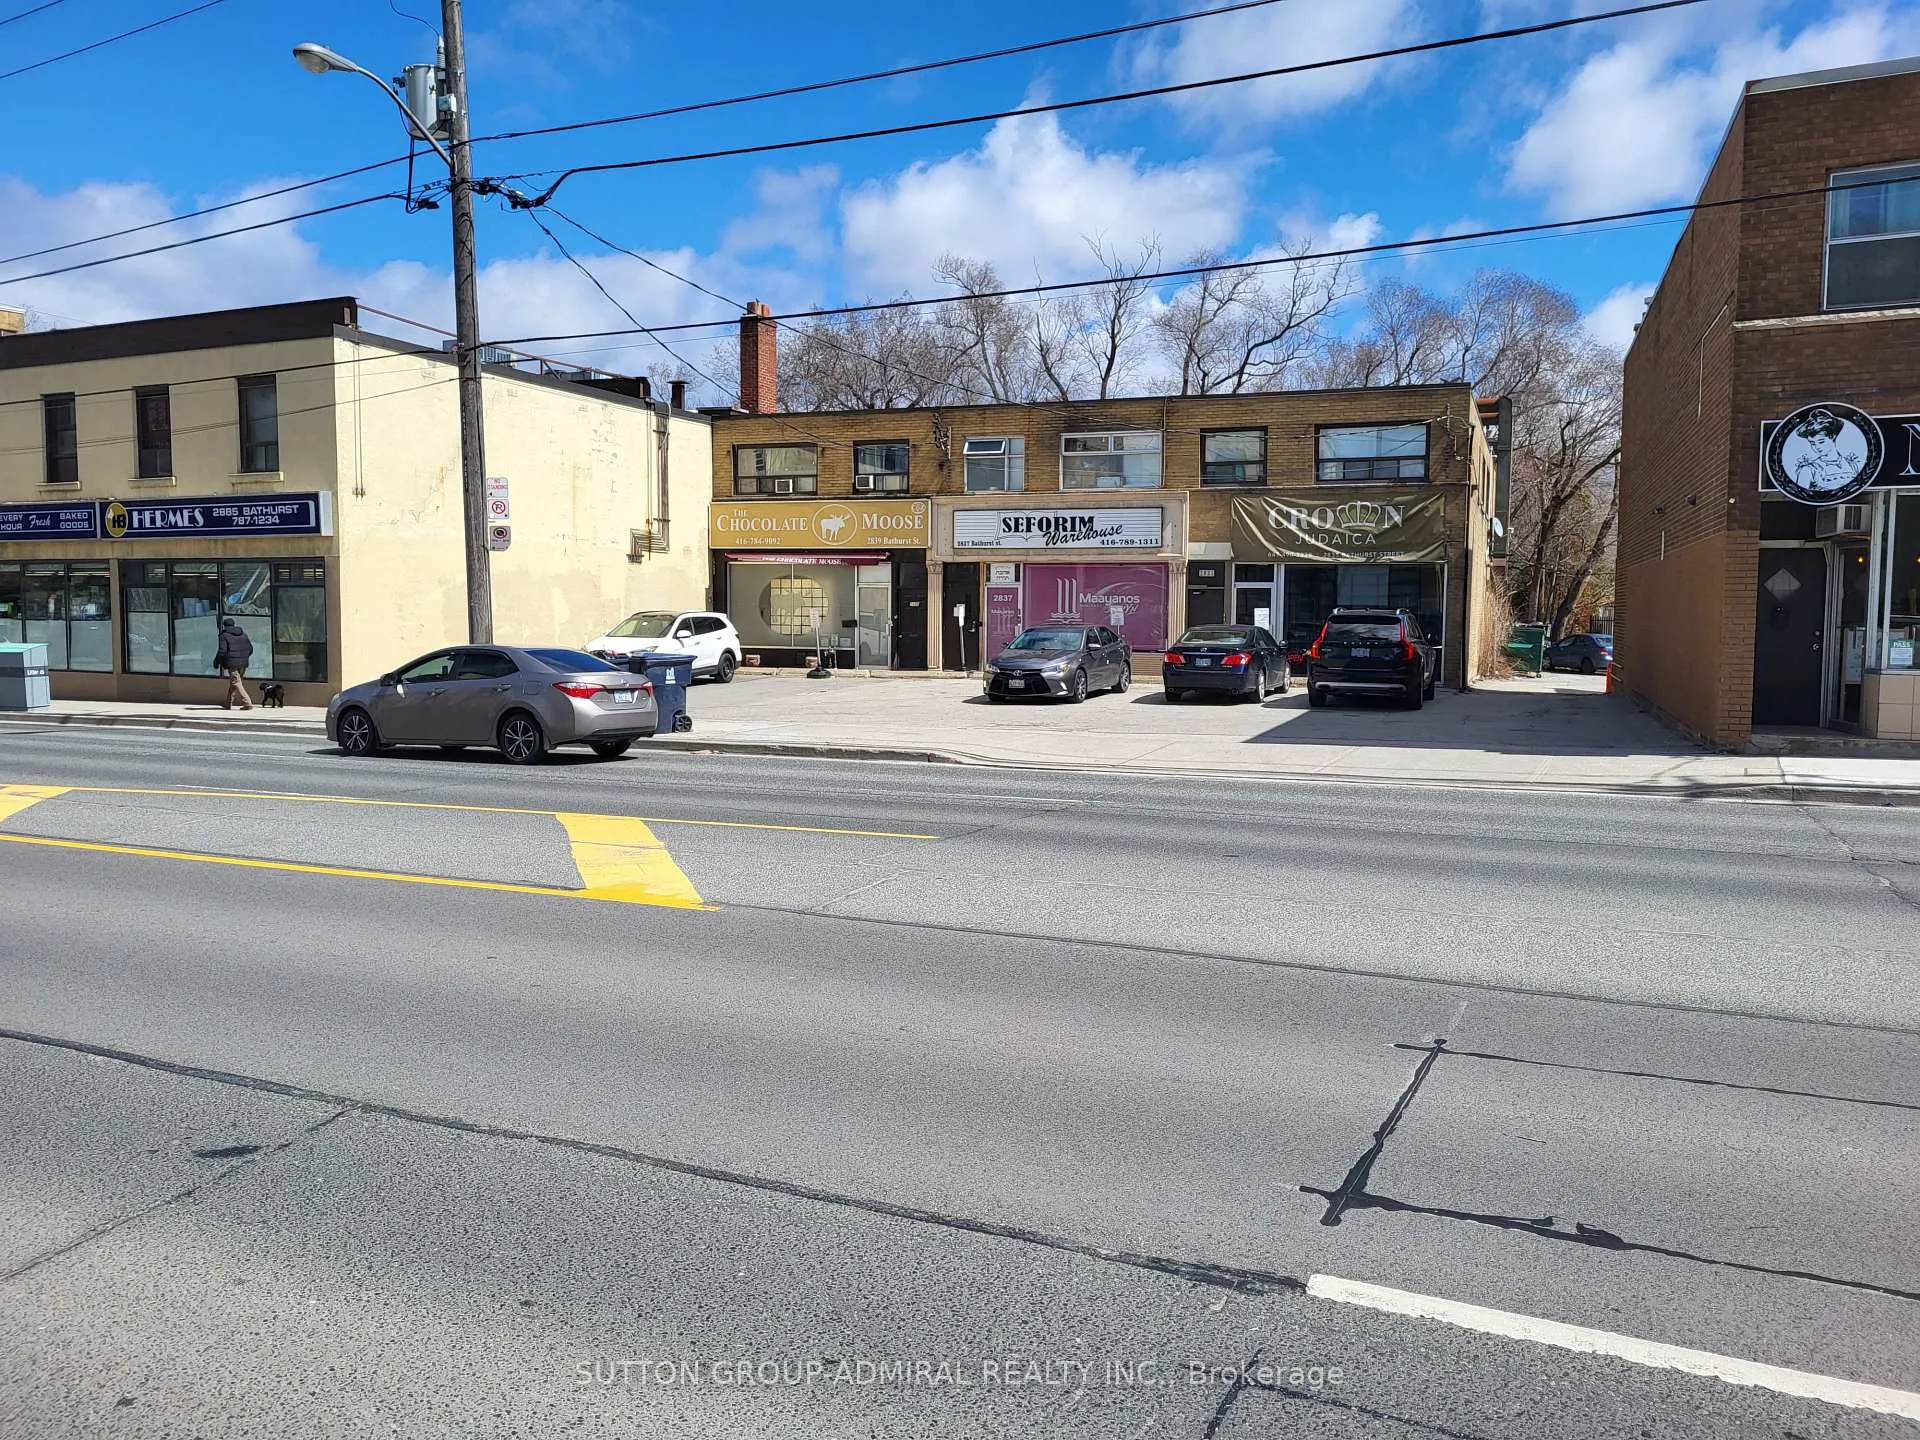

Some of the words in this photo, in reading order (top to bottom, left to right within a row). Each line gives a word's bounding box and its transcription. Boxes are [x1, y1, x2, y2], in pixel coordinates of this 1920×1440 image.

[59, 512, 88, 520] BAKED
[212, 506, 239, 517] 2885
[243, 504, 300, 515] BATHURST
[732, 508, 748, 517] THE
[59, 521, 89, 529] GOODS
[132, 508, 204, 529] HERMES
[716, 514, 809, 532] CHOCOLATE
[861, 513, 924, 530] MOOSE
[1002, 516, 1095, 533] SEFORIM
[883, 536, 911, 545] Bathurst
[1042, 524, 1124, 547] Warehouse
[1099, 538, 1159, 546] 416-789-1311
[1295, 533, 1377, 546] JUDAICA
[992, 594, 1013, 602] 2837
[1079, 592, 1140, 606] Maayanos
